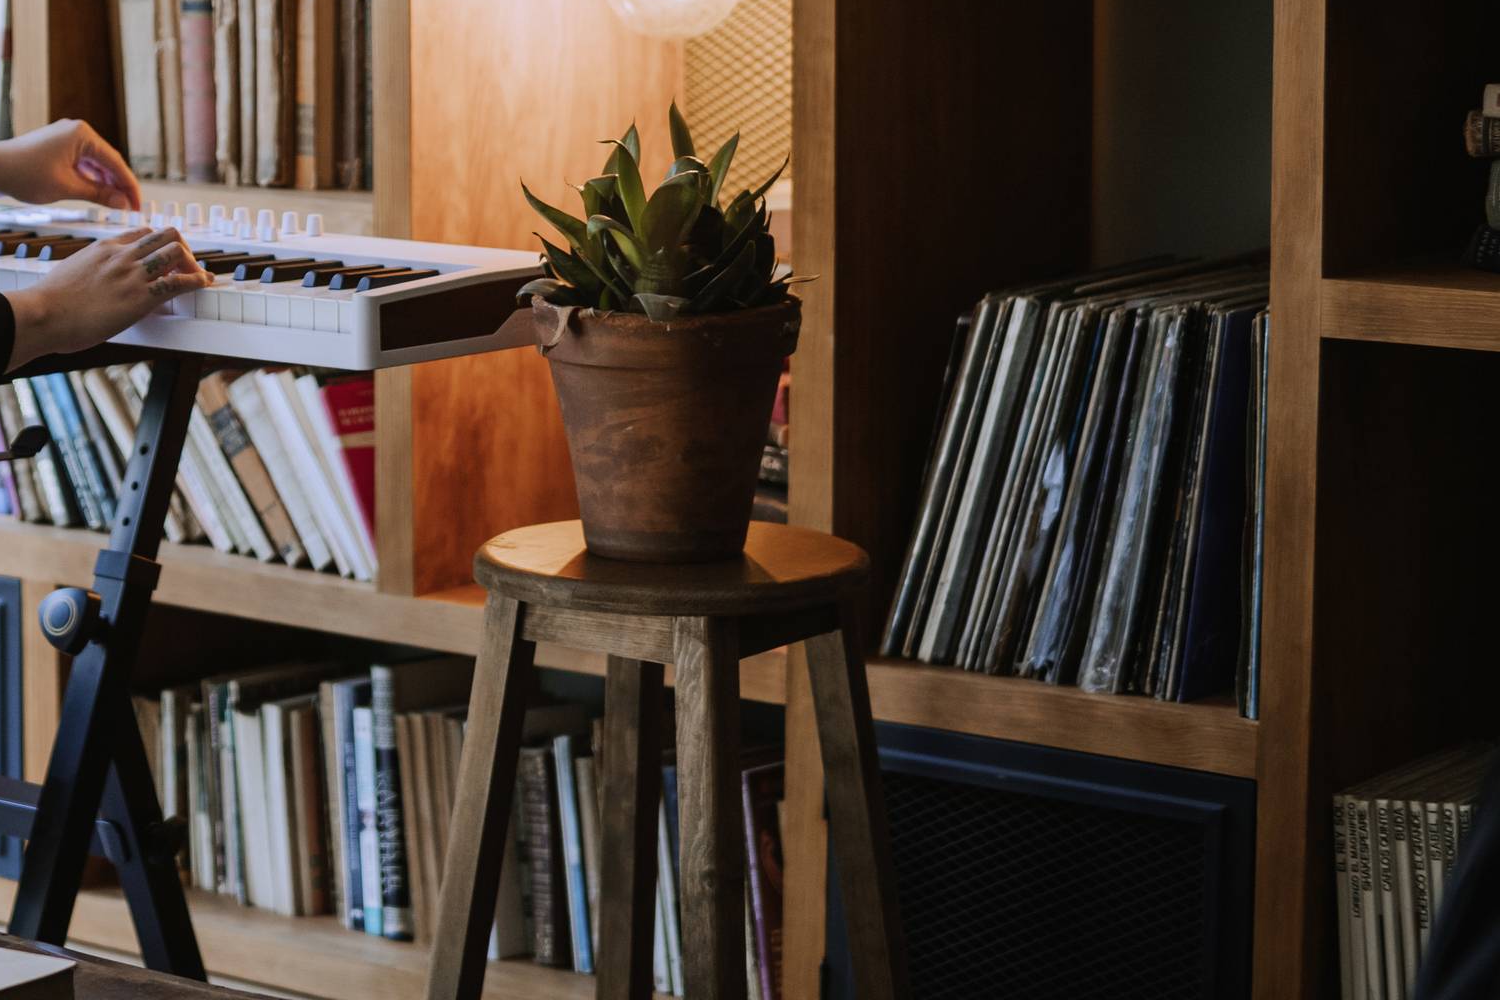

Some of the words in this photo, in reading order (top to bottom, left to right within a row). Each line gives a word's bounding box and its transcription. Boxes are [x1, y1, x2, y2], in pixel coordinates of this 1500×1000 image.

[1334, 831, 1347, 853] REY
[1347, 802, 1359, 859] MAGNIFICO
[1378, 808, 1390, 848] QUINTO
[1393, 808, 1406, 841] BUDA
[1411, 810, 1424, 857] GRANDE
[1428, 824, 1442, 862] ISABEL
[1334, 860, 1347, 873] EL
[1350, 861, 1360, 873] EL
[1357, 810, 1373, 891] SHAKESPEARE
[1414, 859, 1425, 871] EL
[1379, 850, 1392, 892] CARLOS
[1351, 875, 1361, 918] LORENZO
[1415, 874, 1429, 929] FEDERICO
